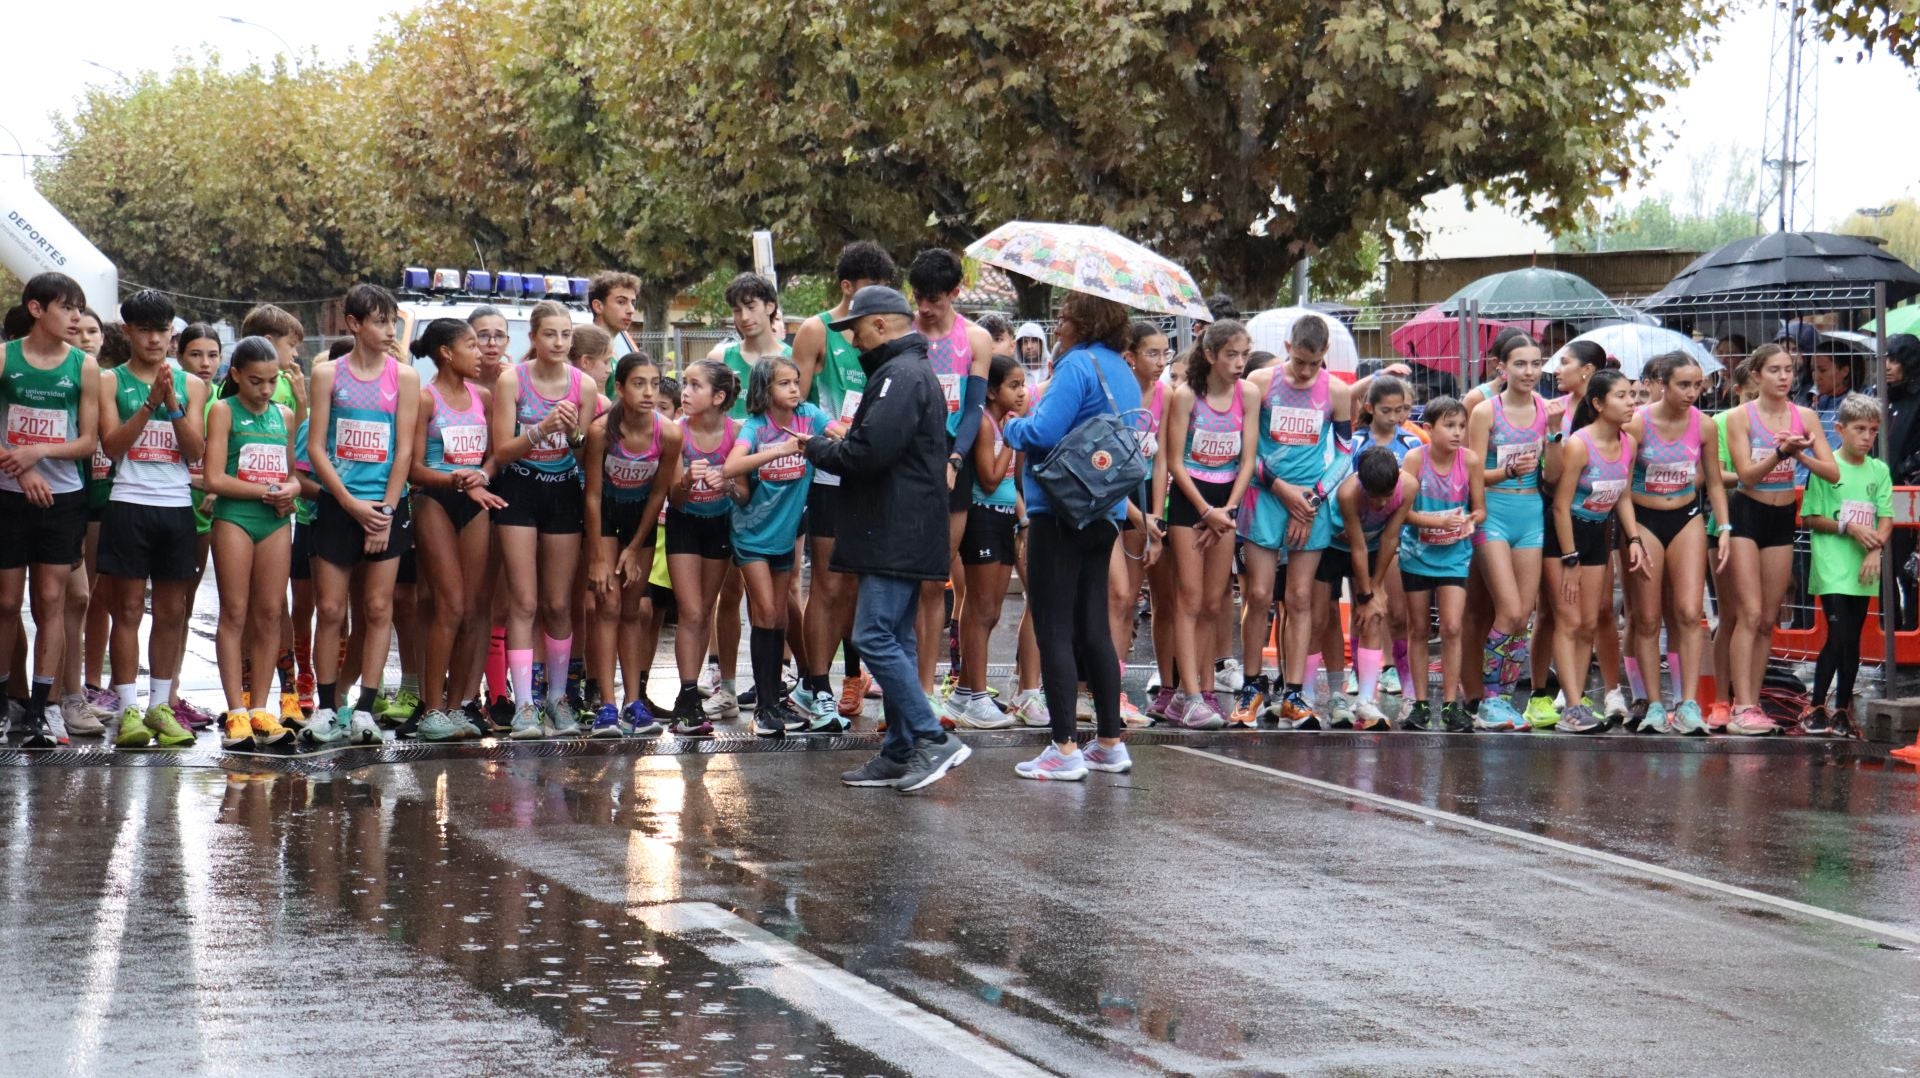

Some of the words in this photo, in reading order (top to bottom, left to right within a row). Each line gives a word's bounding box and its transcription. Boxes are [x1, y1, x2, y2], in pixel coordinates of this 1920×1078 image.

[8, 210, 68, 266] DEPORTES
[25, 388, 66, 399] universidad
[20, 416, 54, 437] 2021
[1280, 416, 1313, 434] 2006
[139, 430, 172, 449] 2018
[344, 429, 381, 449] 2005
[452, 436, 481, 453] 2042
[1200, 440, 1234, 456] 2053
[249, 453, 281, 472] 2063
[535, 472, 567, 483] NIKE
[614, 465, 649, 481] 2037
[1653, 470, 1688, 483] 2048
[1849, 510, 1874, 528] 200
